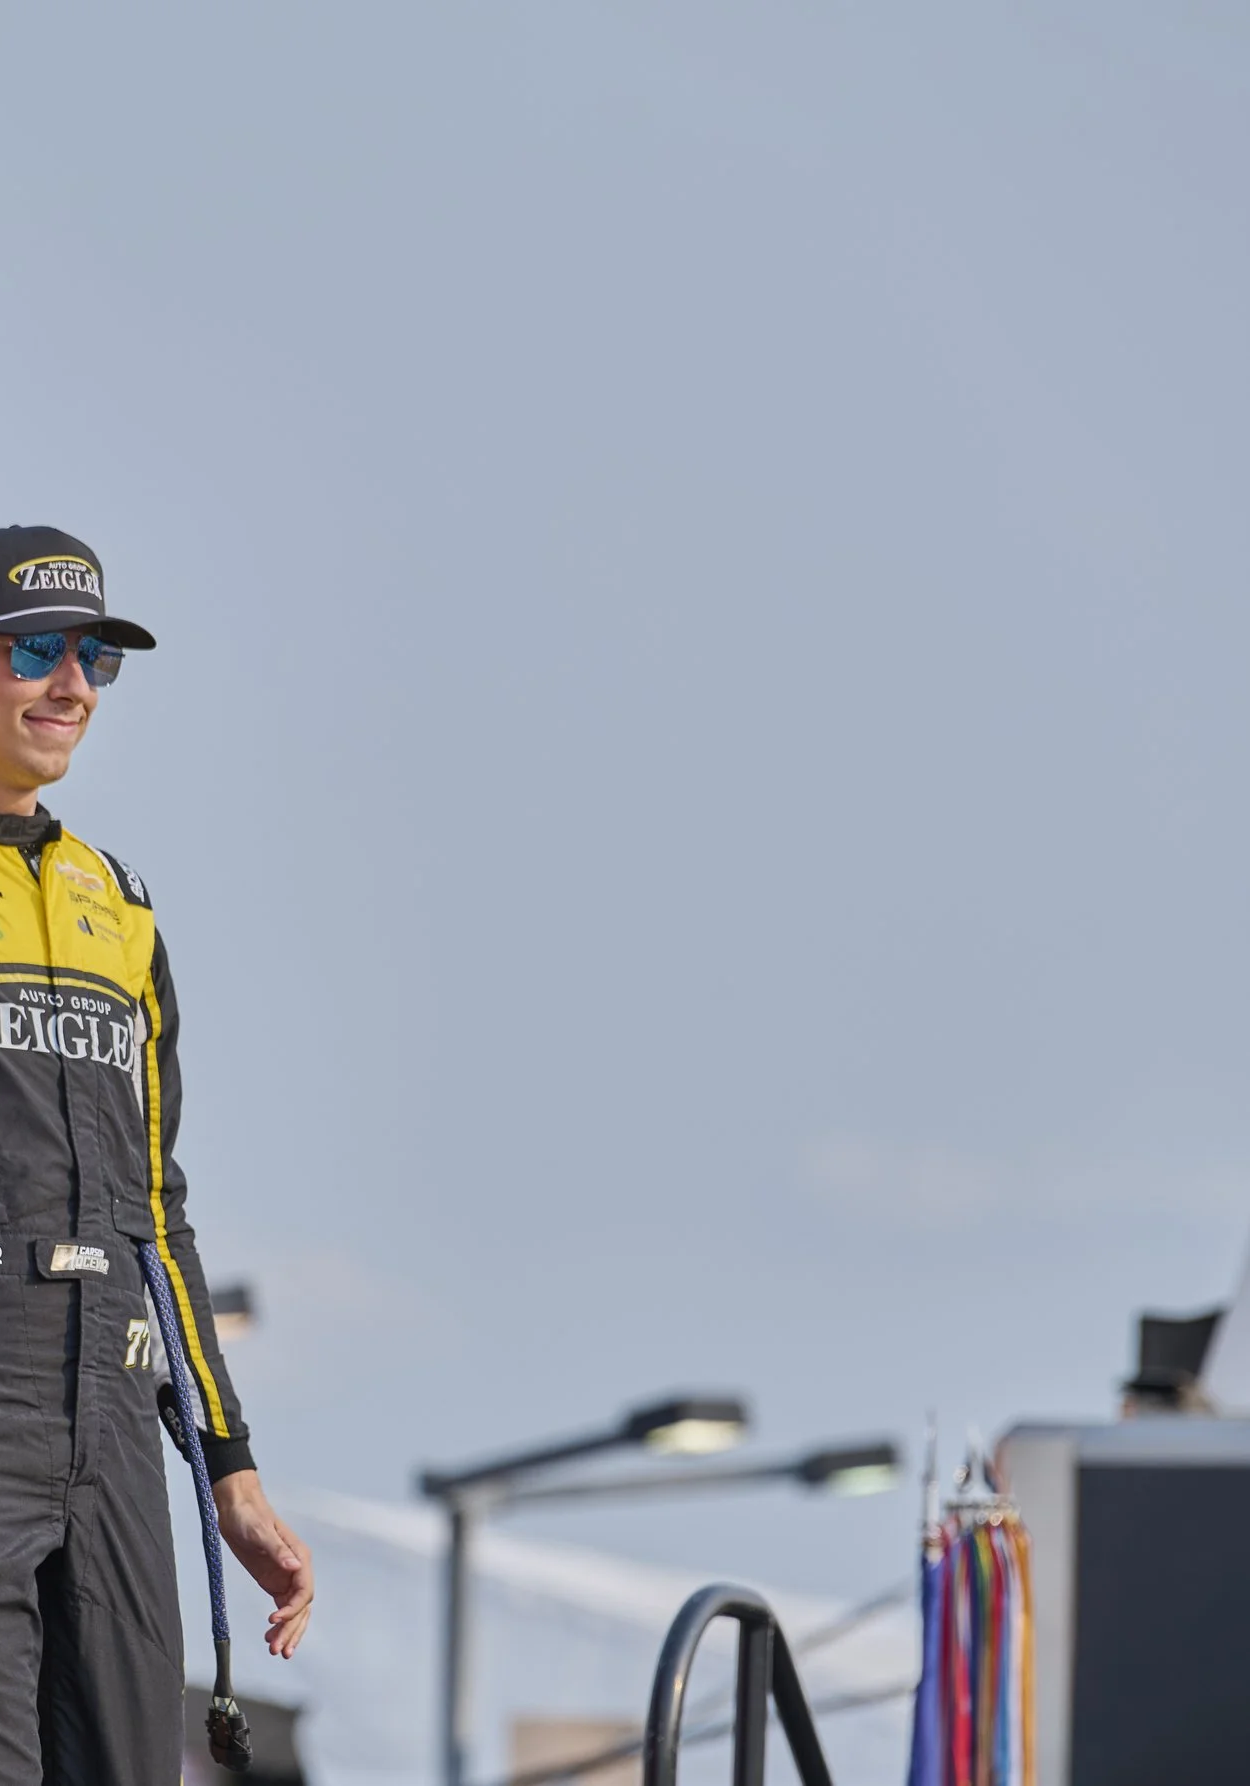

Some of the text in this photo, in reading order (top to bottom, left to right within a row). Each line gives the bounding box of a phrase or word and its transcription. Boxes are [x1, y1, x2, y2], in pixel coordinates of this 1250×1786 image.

[19, 565, 102, 600] ZEIGLER
[19, 987, 112, 1016] AUTO GROUP
[125, 1319, 149, 1370] 77
